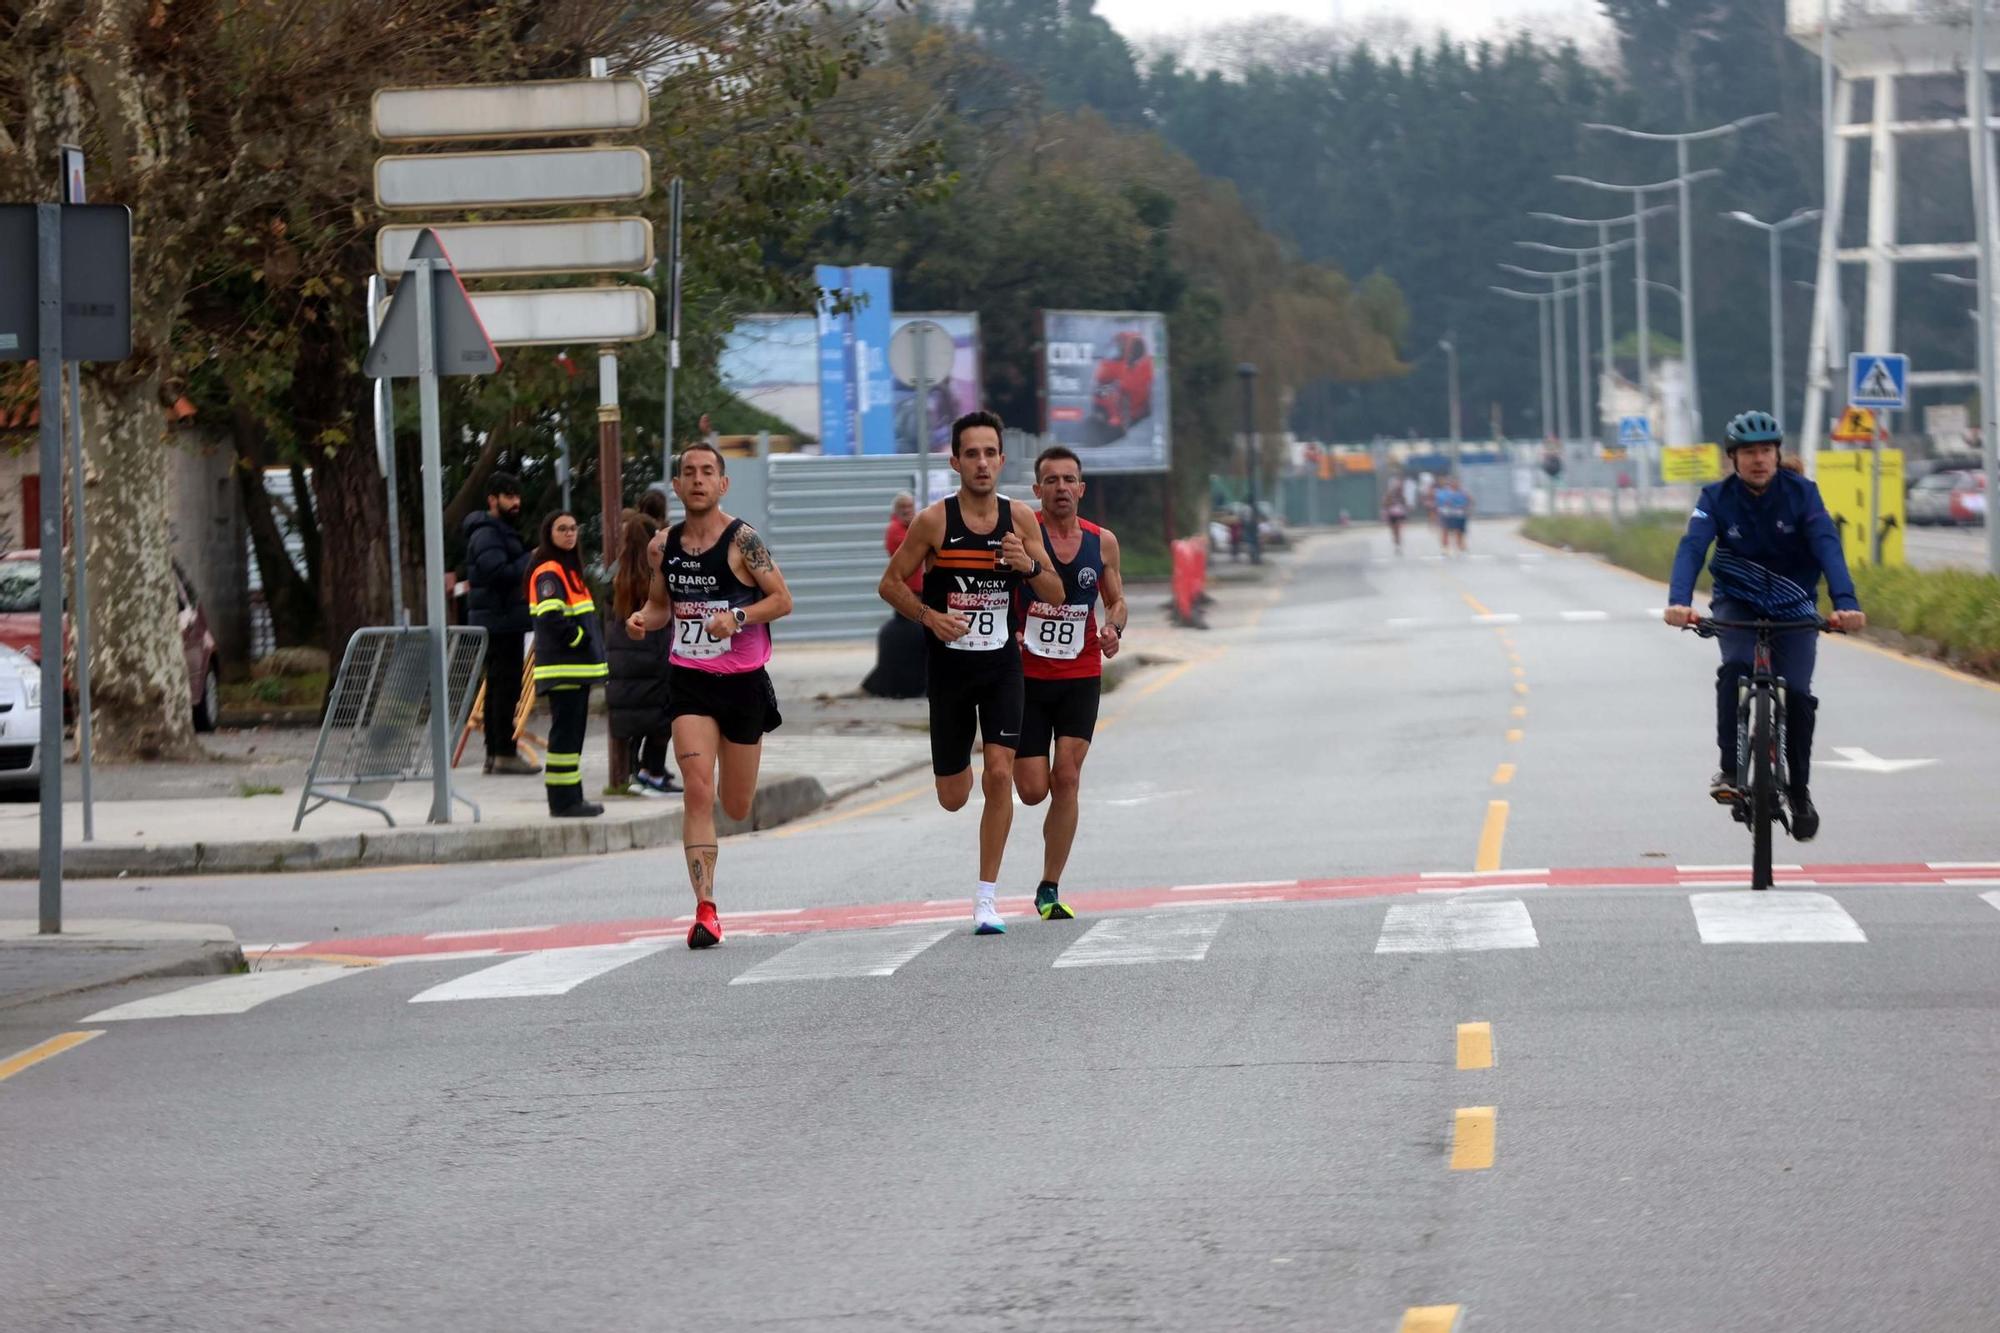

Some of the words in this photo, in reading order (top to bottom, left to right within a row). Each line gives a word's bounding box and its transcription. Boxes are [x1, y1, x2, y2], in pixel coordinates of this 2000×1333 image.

[668, 573, 676, 583] O
[678, 574, 717, 585] BARCO
[976, 580, 1006, 588] VICKY
[963, 612, 994, 635] 78
[1040, 621, 1074, 645] 88
